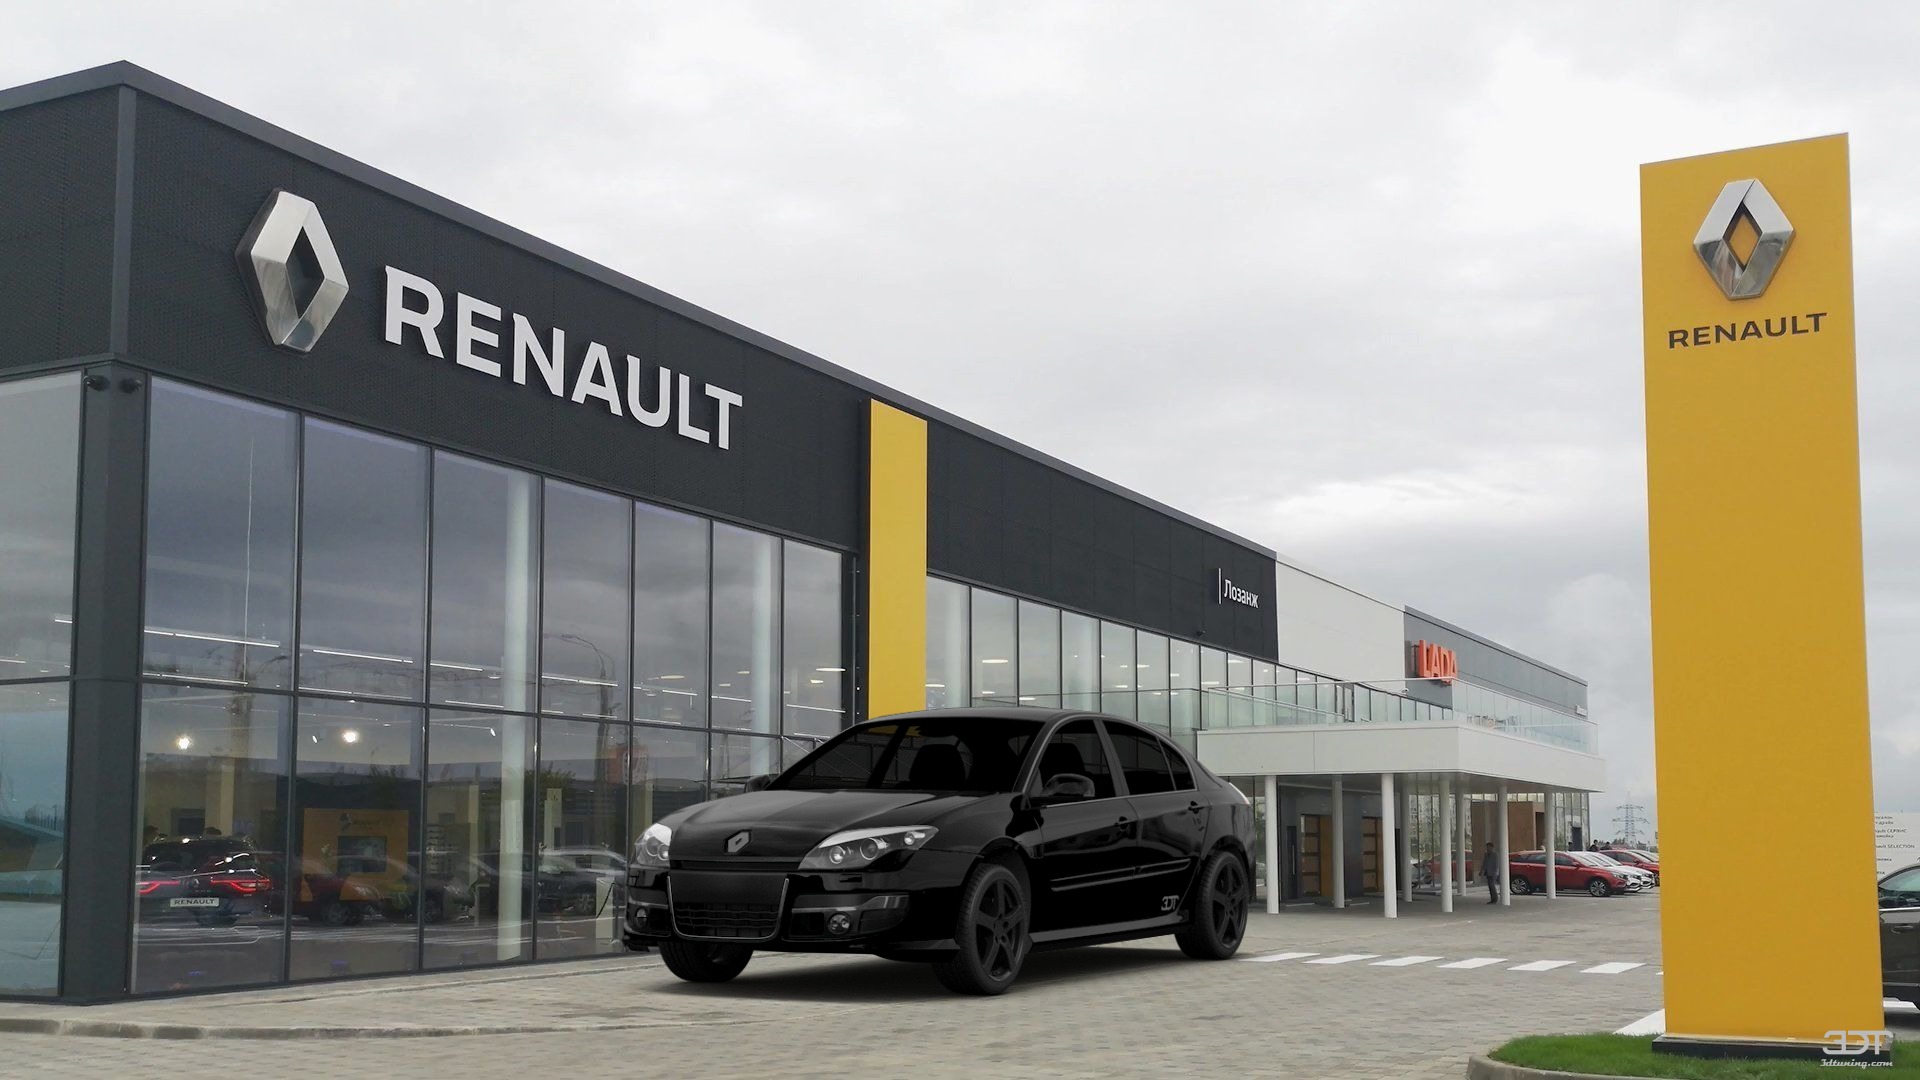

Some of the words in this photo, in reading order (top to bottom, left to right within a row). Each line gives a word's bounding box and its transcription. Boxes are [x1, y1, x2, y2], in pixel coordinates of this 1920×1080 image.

[1668, 312, 1827, 349] RENAULT
[384, 264, 743, 451] RENAULT
[1224, 579, 1259, 609] Лозанж
[1418, 639, 1457, 686] LADA
